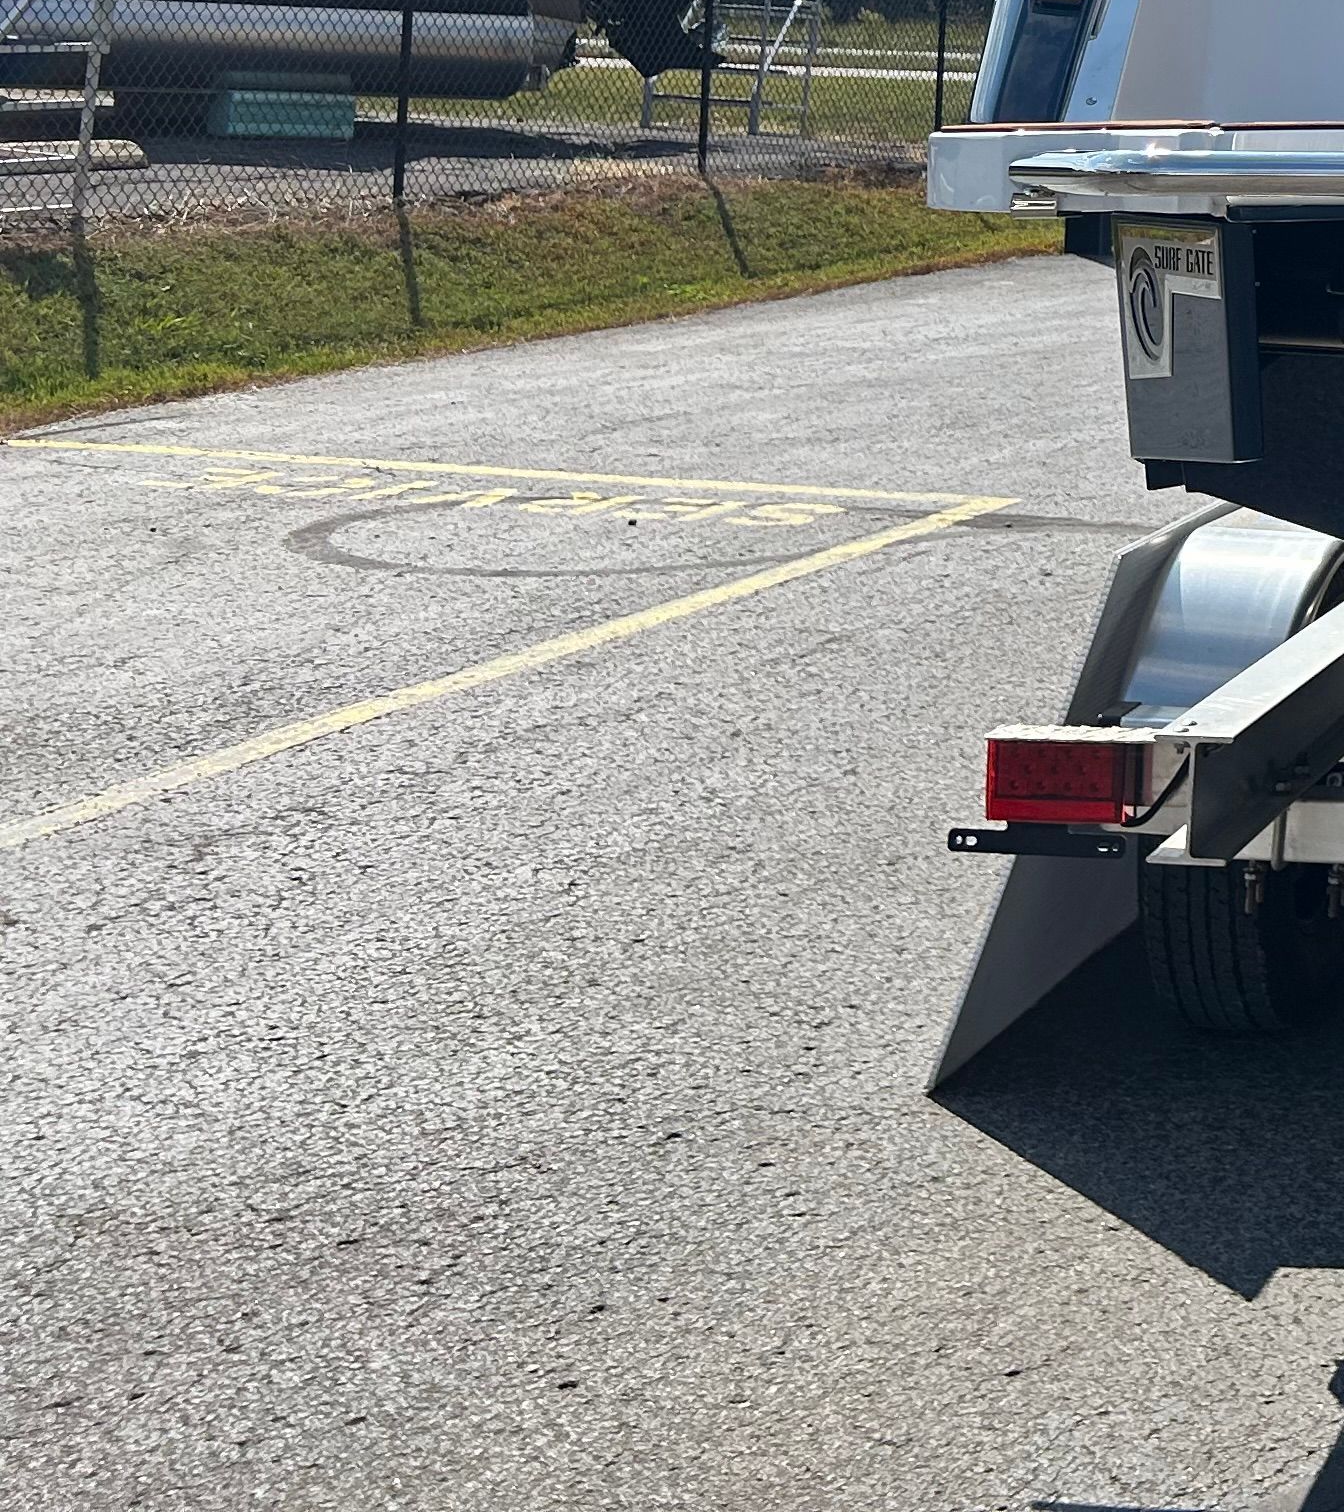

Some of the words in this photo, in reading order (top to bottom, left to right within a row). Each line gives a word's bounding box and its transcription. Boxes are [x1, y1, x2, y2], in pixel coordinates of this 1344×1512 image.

[1154, 245, 1182, 272] SURF
[1186, 248, 1214, 276] GATE
[137, 467, 848, 527] SERVICE
